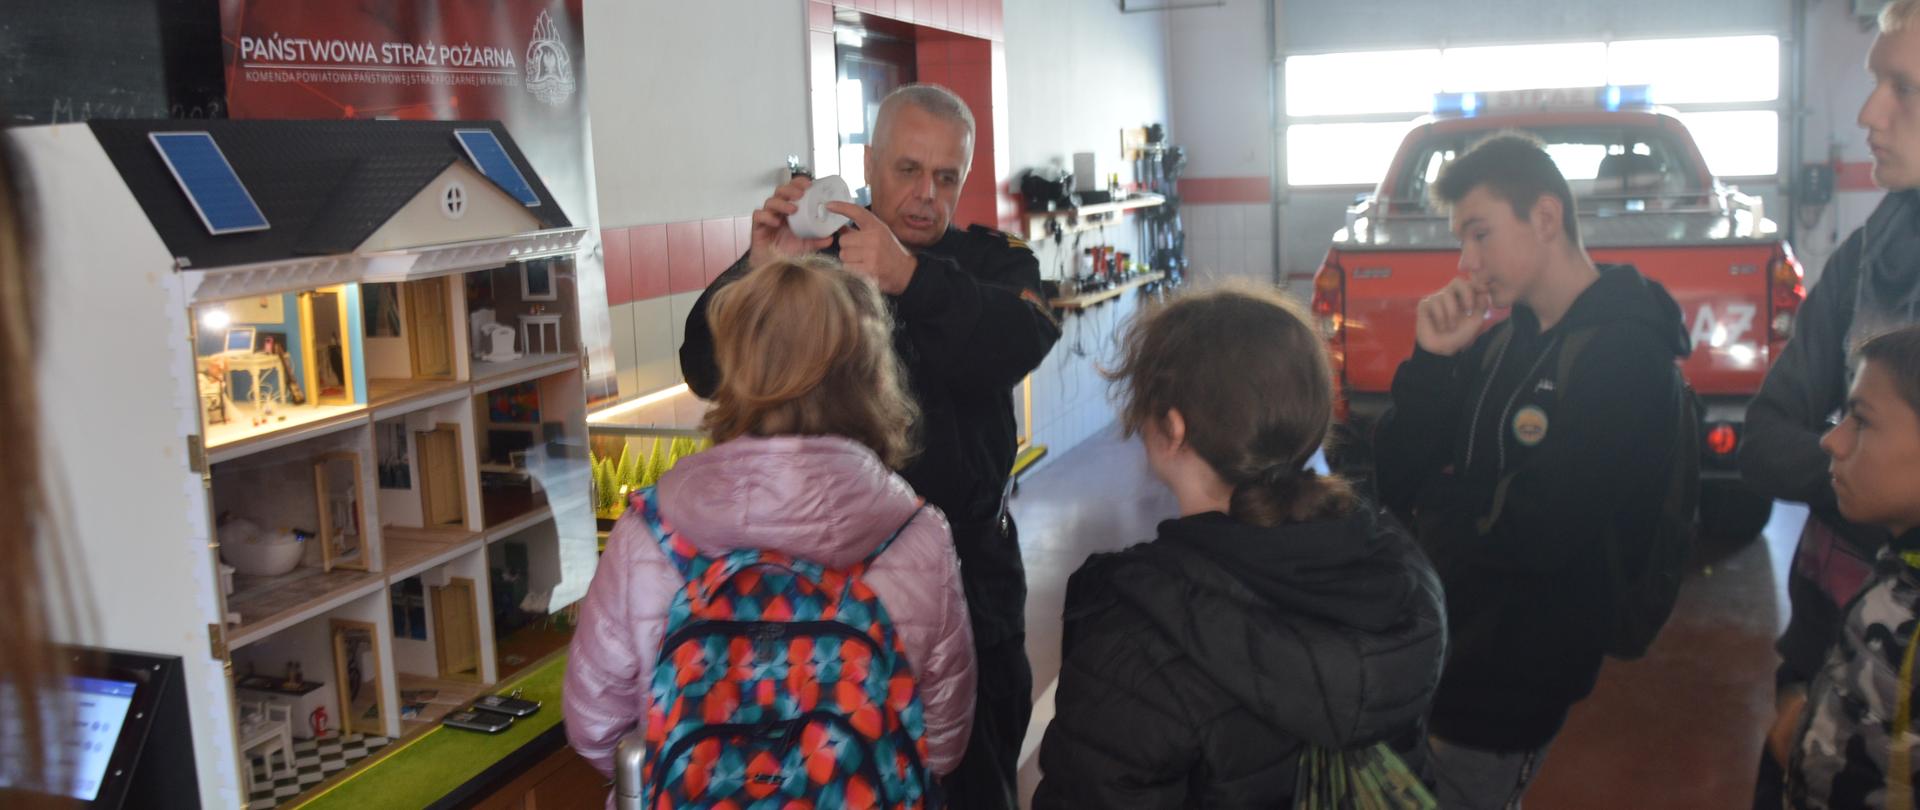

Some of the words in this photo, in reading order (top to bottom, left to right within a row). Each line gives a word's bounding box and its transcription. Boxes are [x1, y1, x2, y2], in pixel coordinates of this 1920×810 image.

[240, 32, 379, 63] PAŃSTWOWA
[381, 40, 437, 65] STRAŻ
[440, 41, 516, 68] POŻARNA
[246, 71, 294, 82] KOMENDA
[296, 72, 353, 84] POWIATOWA
